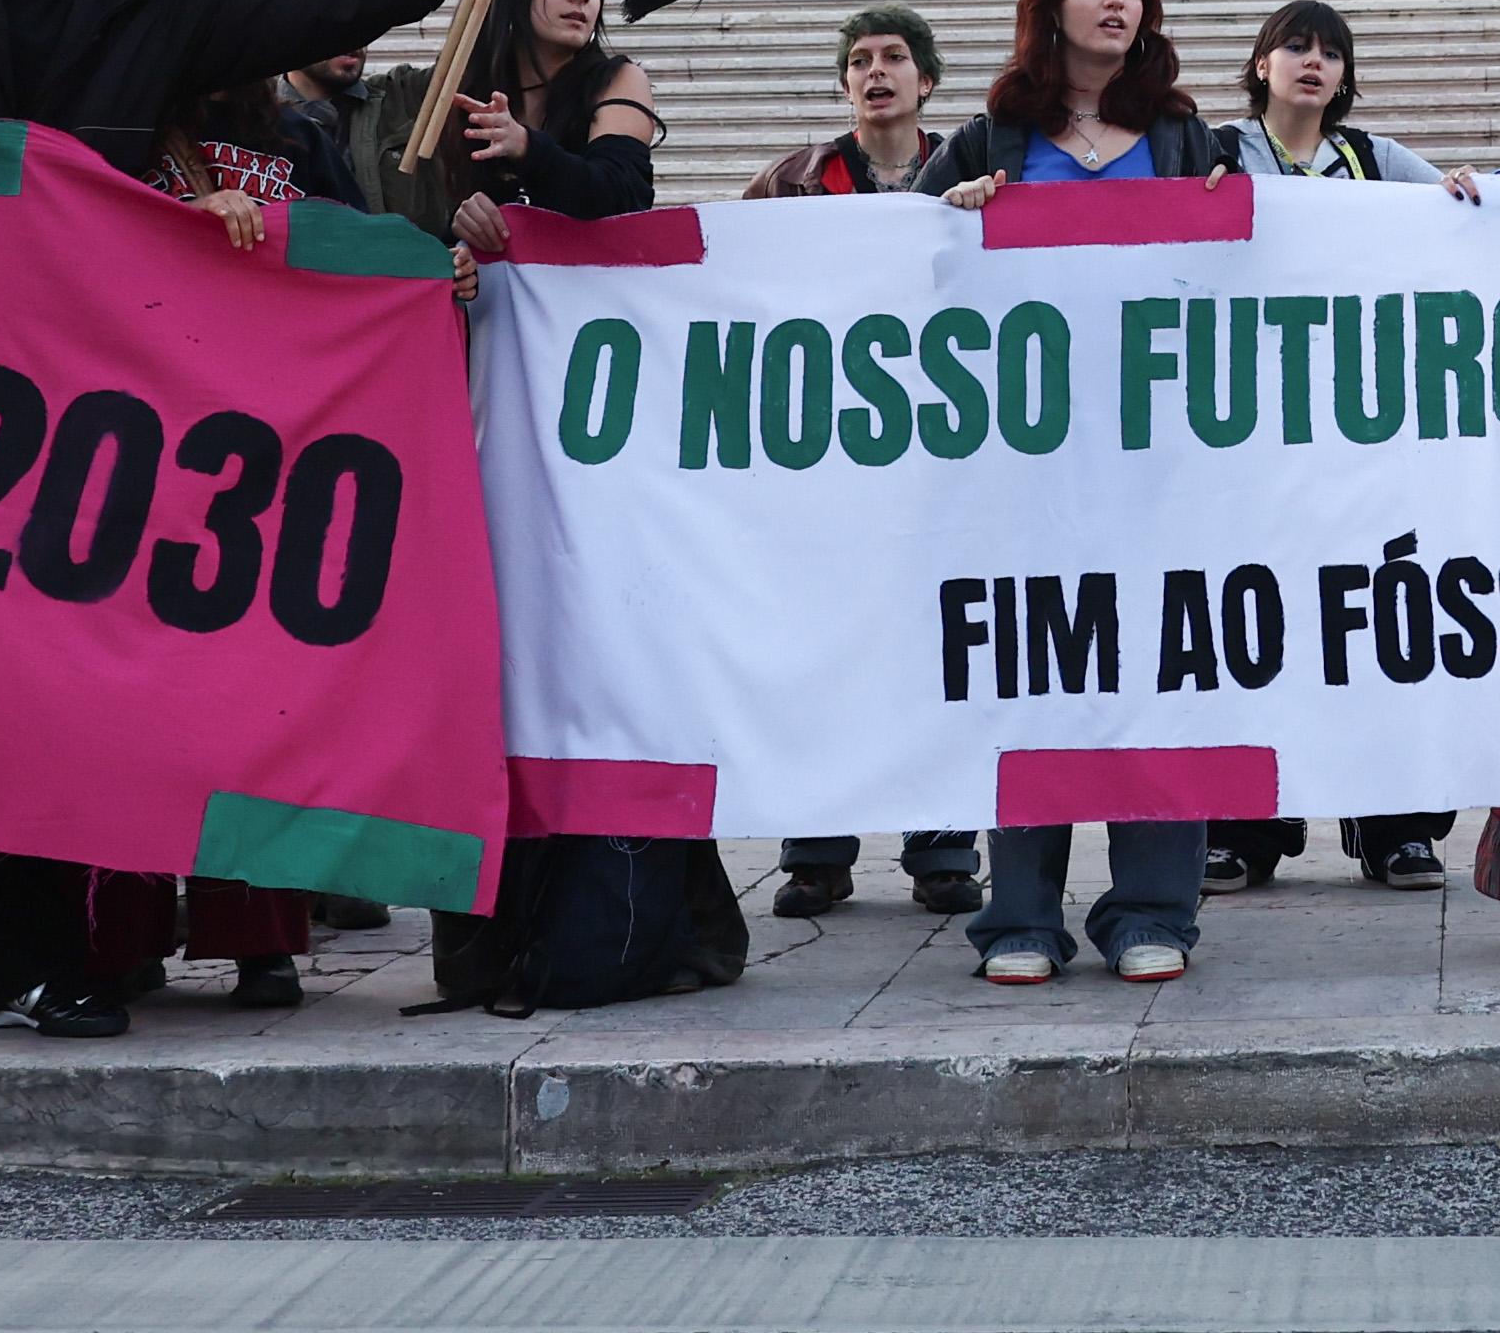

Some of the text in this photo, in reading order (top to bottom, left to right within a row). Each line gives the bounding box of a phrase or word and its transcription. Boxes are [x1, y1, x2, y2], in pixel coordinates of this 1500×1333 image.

[559, 318, 642, 466] O
[679, 300, 1071, 471] NOSSO
[939, 572, 1121, 702] FIM
[1157, 563, 1286, 693] AO
